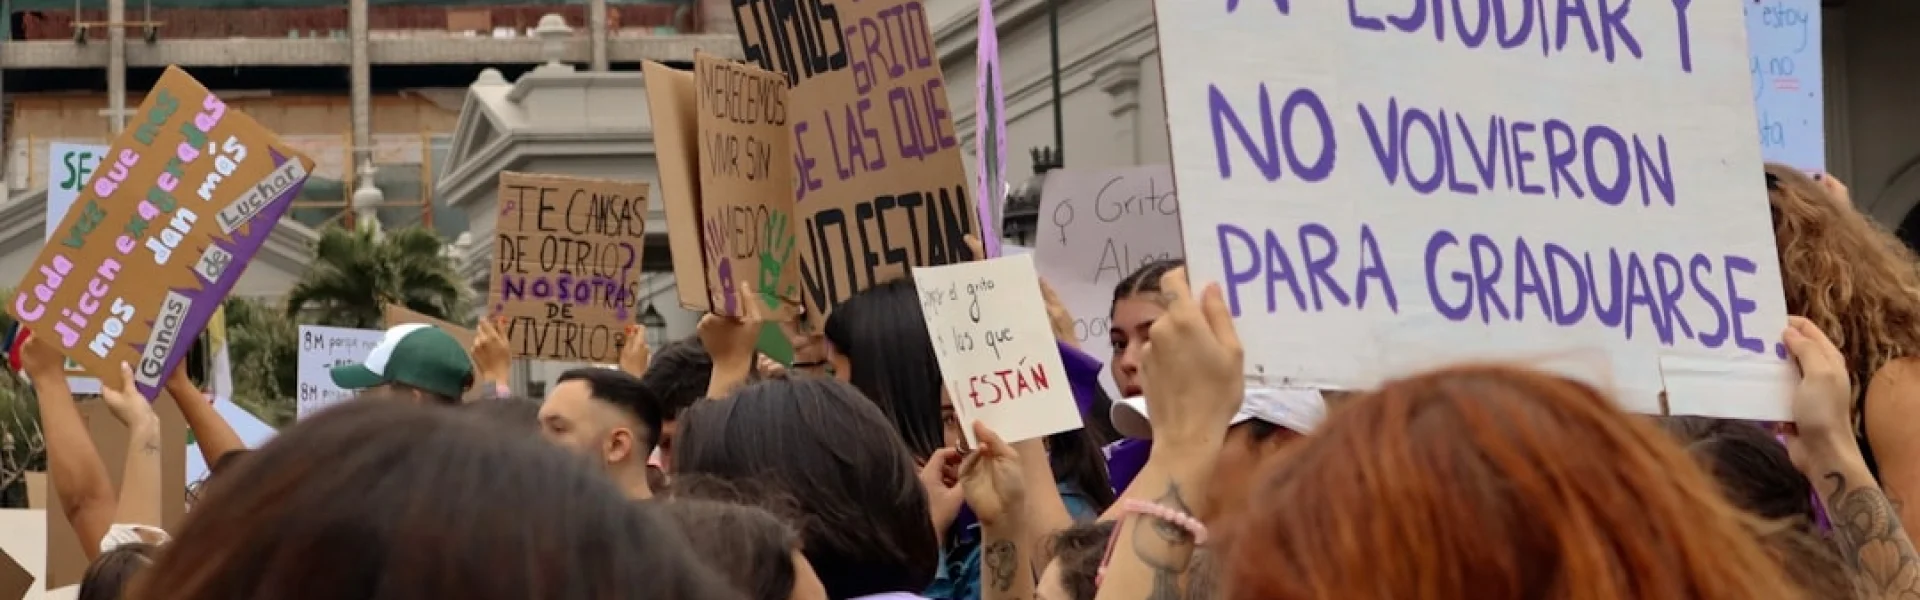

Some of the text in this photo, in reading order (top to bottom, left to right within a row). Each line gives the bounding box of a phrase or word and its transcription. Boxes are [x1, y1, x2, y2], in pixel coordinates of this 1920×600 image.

[846, 1, 932, 96] GRITO
[1348, 0, 1642, 63] UDIAR
[1762, 2, 1808, 54] estoy
[1770, 56, 1795, 76] no
[701, 59, 787, 127] MERECEMOS
[823, 98, 887, 181] LAS
[887, 78, 957, 161] QUE
[1206, 82, 1677, 207] NO VOLVIERON
[745, 135, 771, 181] SIN
[14, 254, 74, 322] Cada
[60, 200, 107, 250] vez
[133, 88, 180, 146] nos
[54, 93, 227, 348] dicen exageradas
[507, 185, 646, 238] TE CANSAS
[1095, 176, 1178, 223] Grito
[89, 135, 248, 359] nos dan más
[140, 162, 299, 379] Ganas de Luchar
[500, 234, 530, 275] DE
[800, 208, 858, 316] NO
[503, 275, 638, 309] NOSOTRAS
[544, 302, 575, 319] DE
[966, 277, 995, 324] grito
[1216, 223, 1788, 360] PARA GRADUARSE.
[304, 330, 325, 352] 8M
[985, 328, 1014, 361] que
[301, 382, 317, 401] 8M
[968, 355, 1050, 408] ESTÁN
